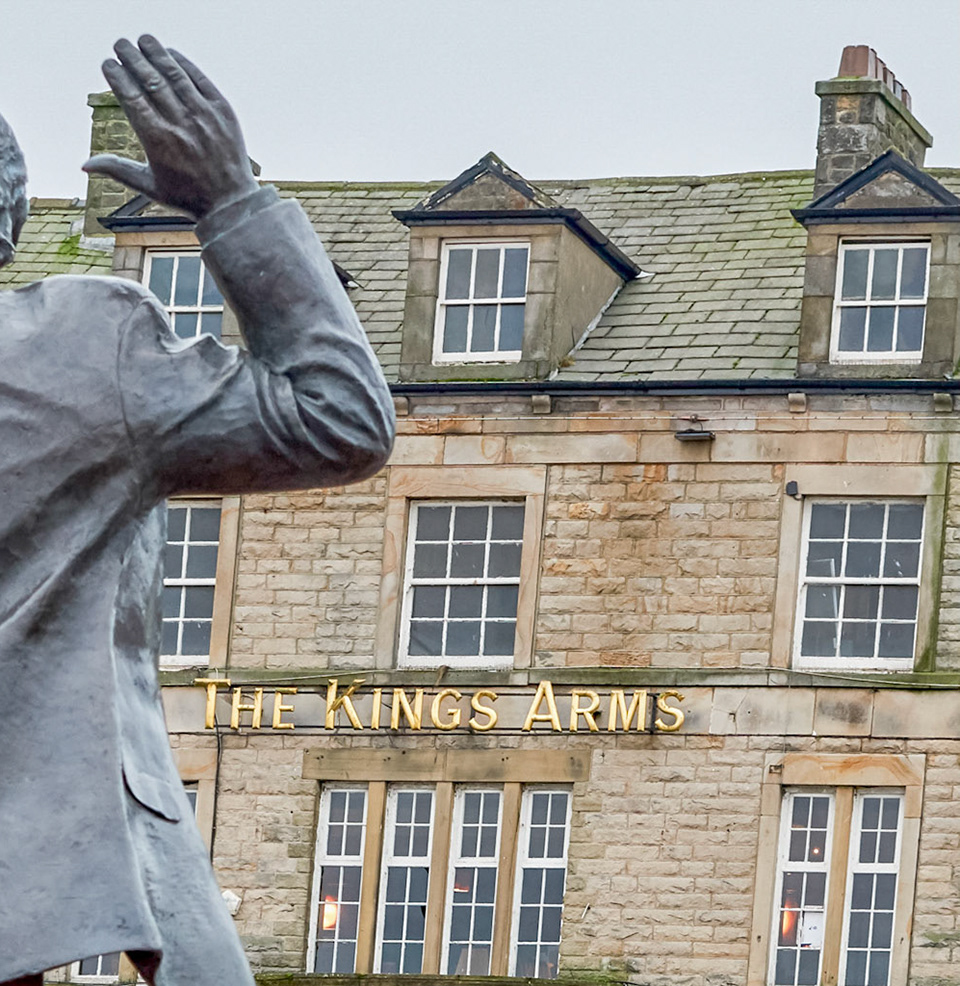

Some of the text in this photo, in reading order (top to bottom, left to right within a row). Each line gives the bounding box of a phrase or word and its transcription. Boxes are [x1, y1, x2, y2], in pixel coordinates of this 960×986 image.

[194, 678, 686, 733] THE KINGS ARMS
